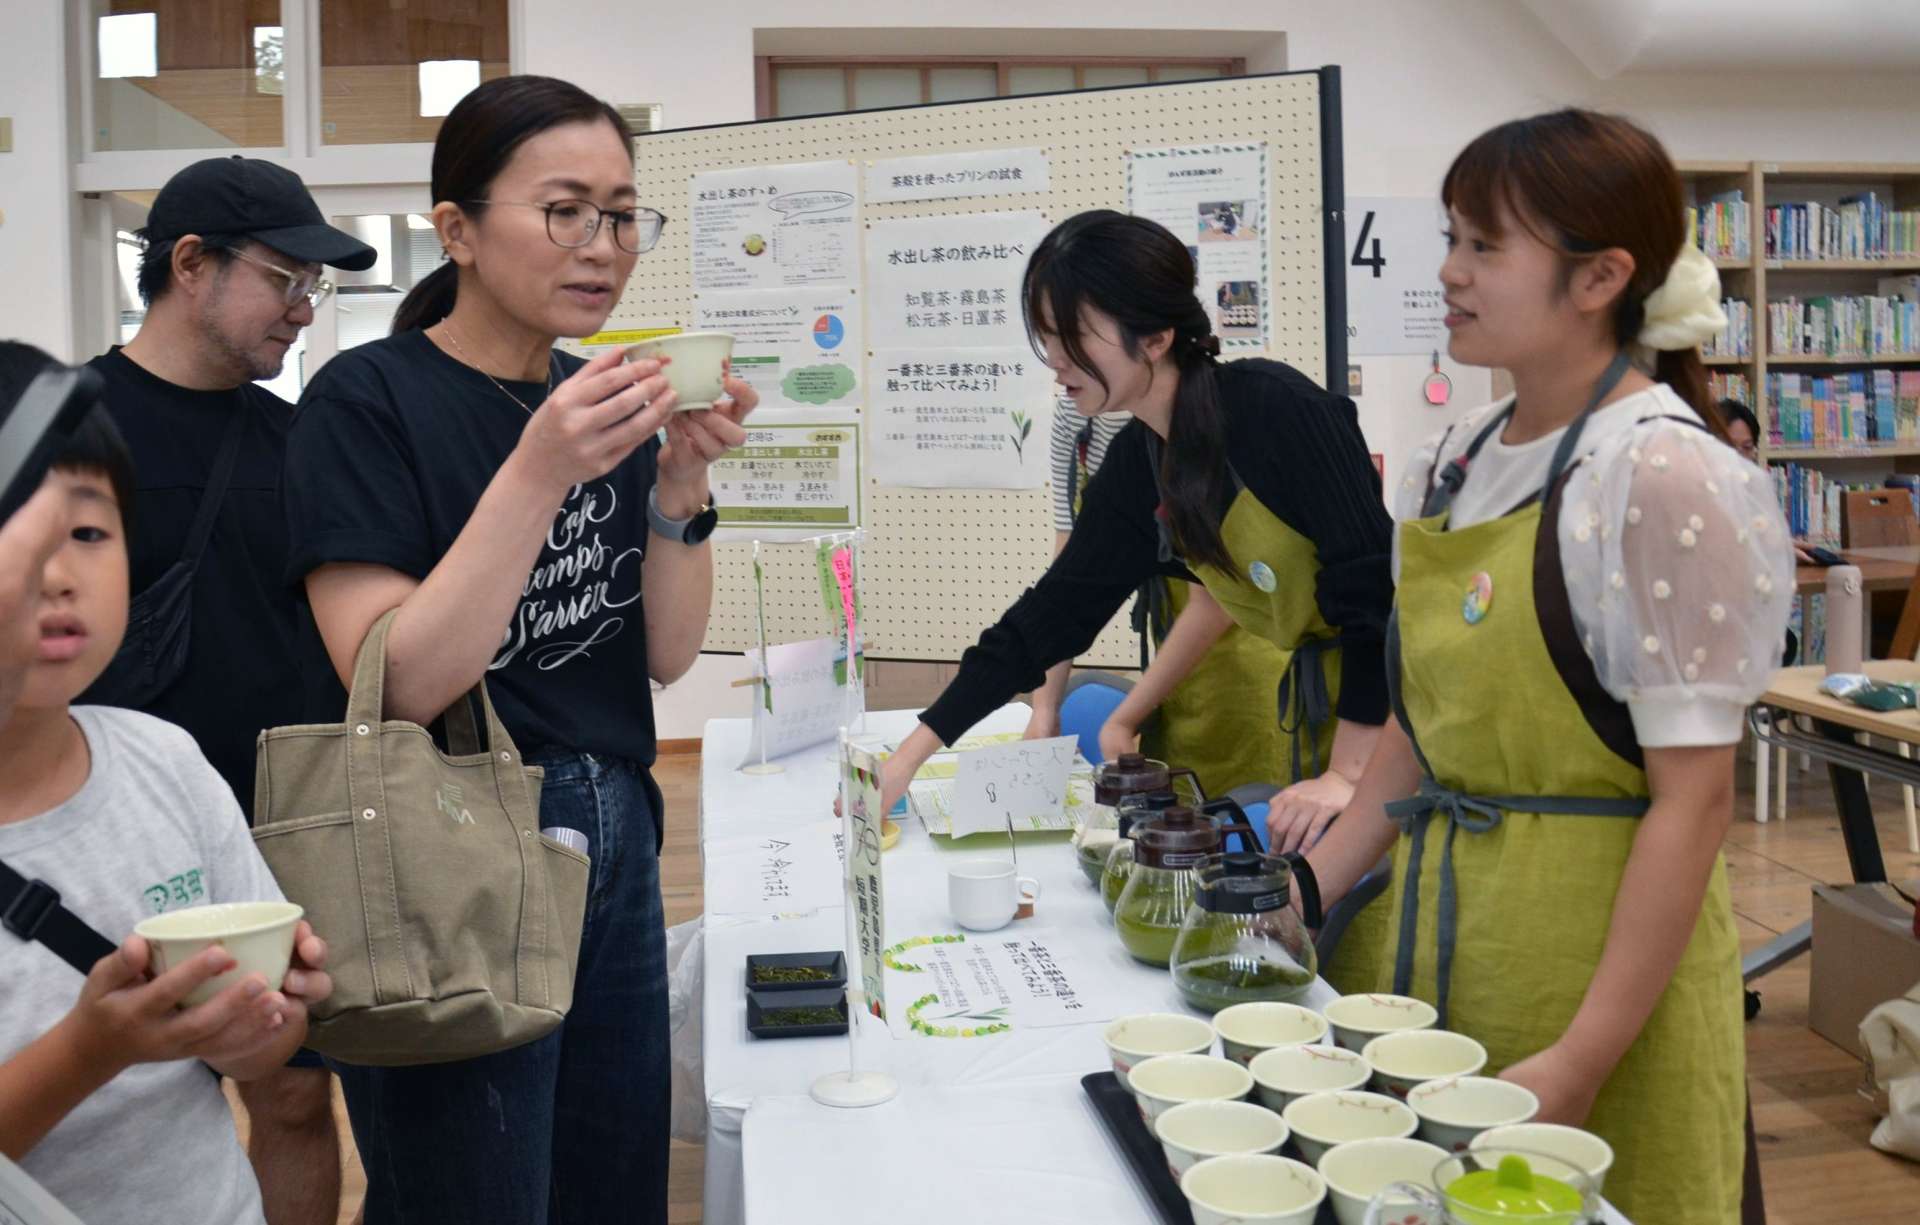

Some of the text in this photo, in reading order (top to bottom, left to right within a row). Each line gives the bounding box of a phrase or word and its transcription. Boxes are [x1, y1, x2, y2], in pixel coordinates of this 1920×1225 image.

[888, 243, 1025, 265] 水出し茶の飲み比べ
[1351, 211, 1386, 278] 4
[905, 288, 1007, 308] 知覧茶・霧島茶
[906, 309, 1008, 328] 松元茶・日置茶
[887, 363, 1024, 377] 一番茶と三番茶の違いを
[547, 483, 616, 550] Café
